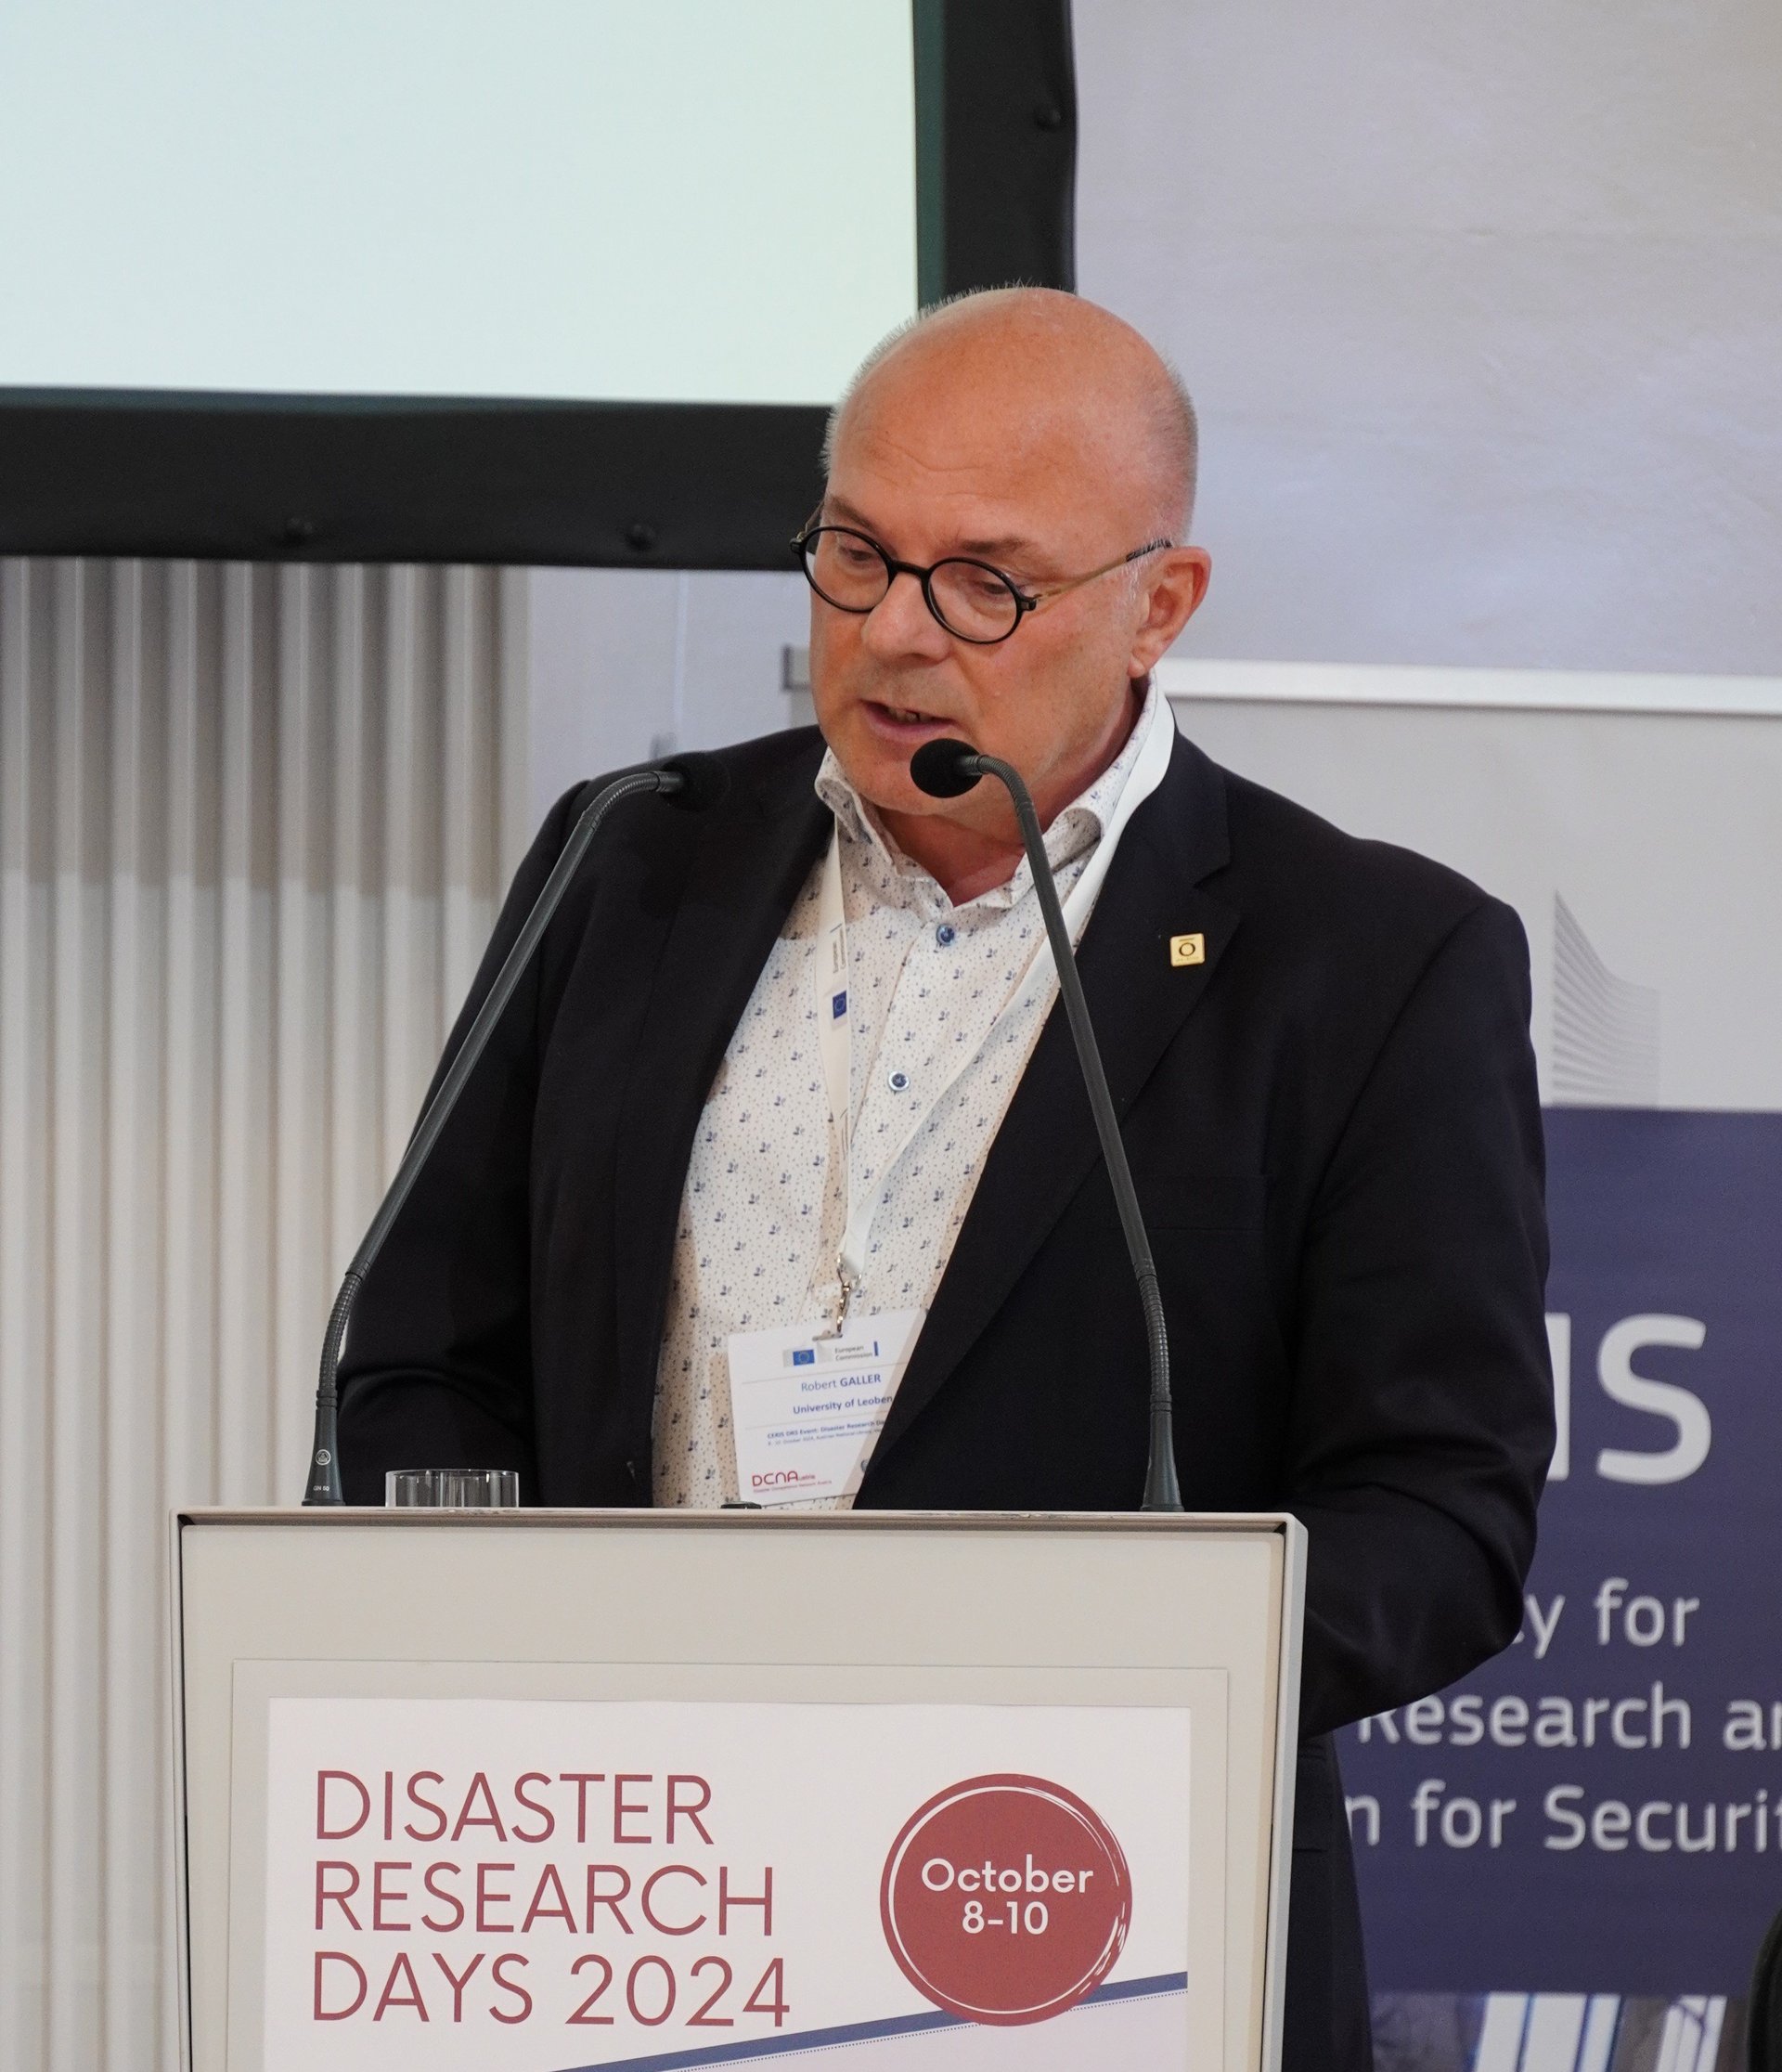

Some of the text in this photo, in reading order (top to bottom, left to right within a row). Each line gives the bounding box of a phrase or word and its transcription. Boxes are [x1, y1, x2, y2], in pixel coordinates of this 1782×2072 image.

[793, 1395, 893, 1415] University of Leoben
[801, 1373, 882, 1392] Robert GALLER
[1594, 1577, 1700, 1648] for
[318, 1770, 714, 1845] DISASTER
[1411, 1778, 1517, 1849] for
[1543, 1784, 1782, 1852] Securi
[316, 1861, 774, 1936] RESEARCH
[921, 1853, 1094, 1895] October
[962, 1900, 1050, 1936] 8-10
[314, 1951, 790, 2027] DAYS 2024
